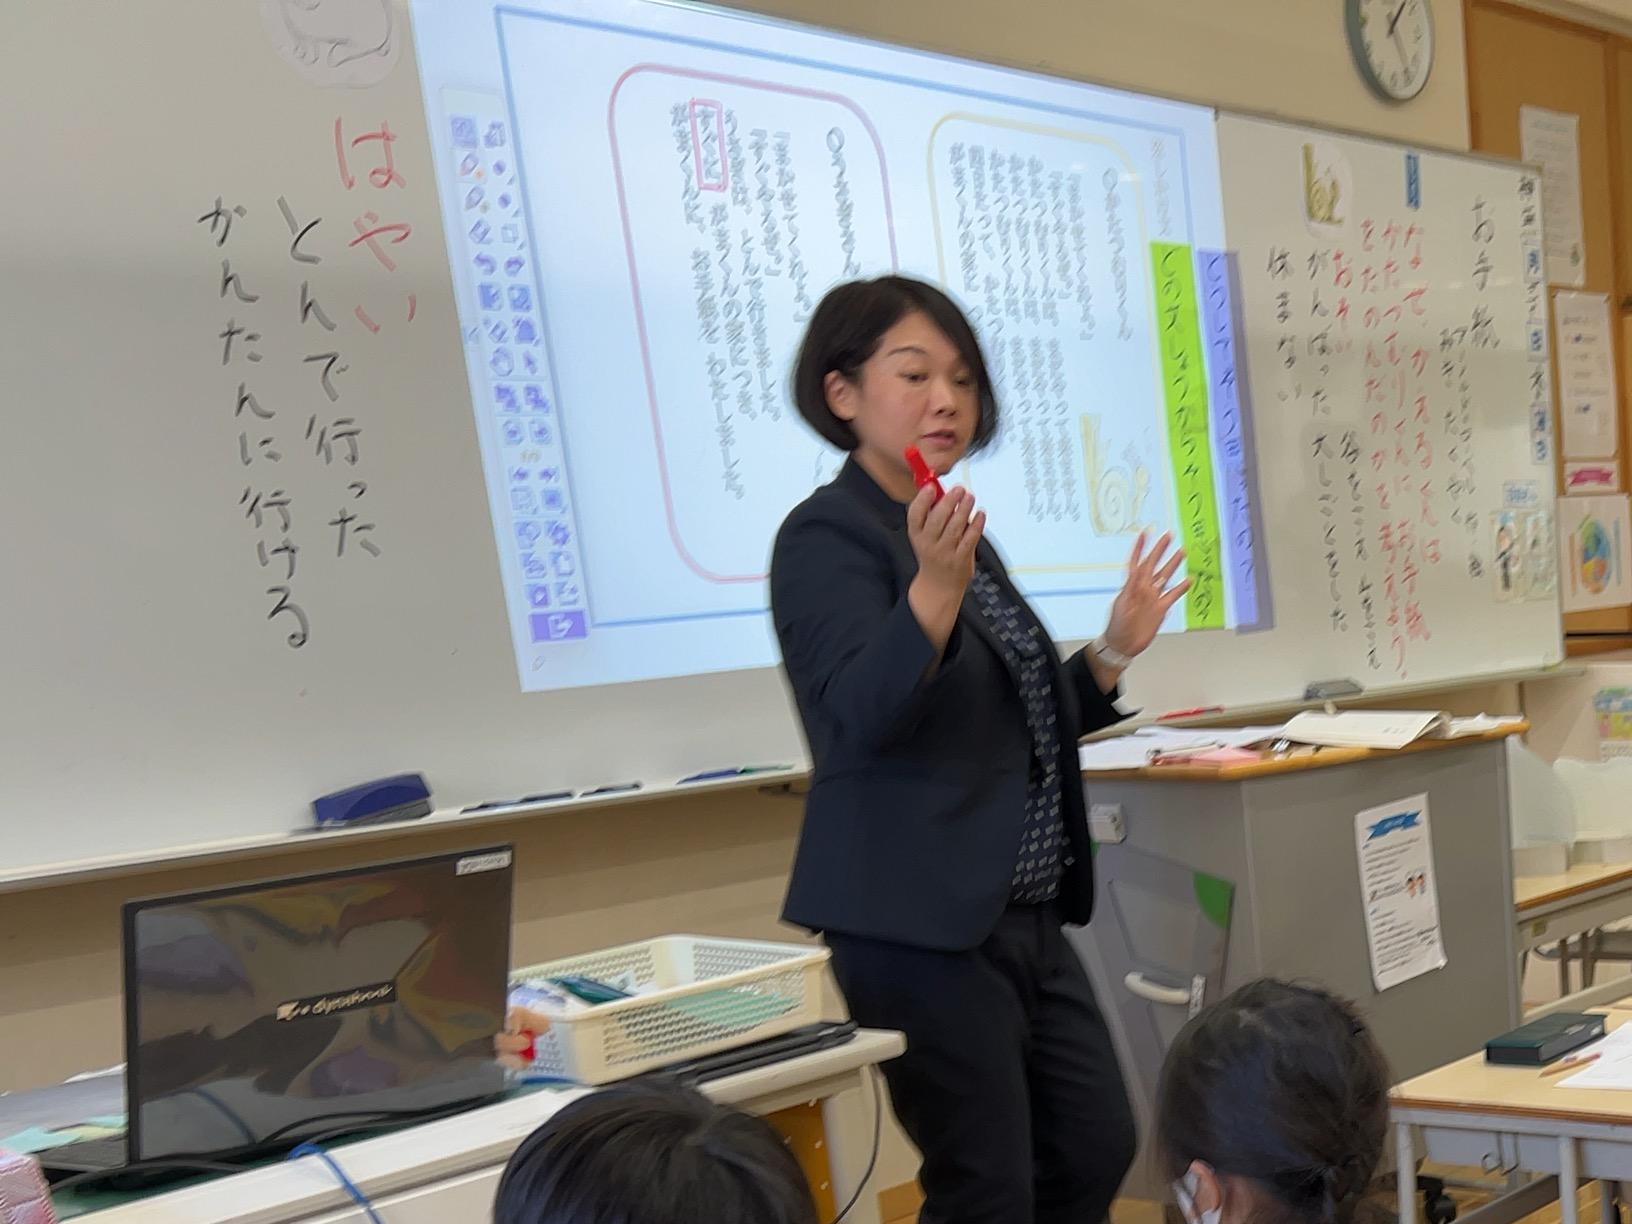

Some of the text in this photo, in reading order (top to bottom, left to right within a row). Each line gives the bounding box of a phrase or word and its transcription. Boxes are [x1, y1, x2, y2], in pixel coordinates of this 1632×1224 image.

[335, 115, 417, 334] はやい
[1470, 195, 1500, 350] お手紙
[198, 196, 310, 649] かんたんに行ける
[277, 195, 382, 558] とんで行った
